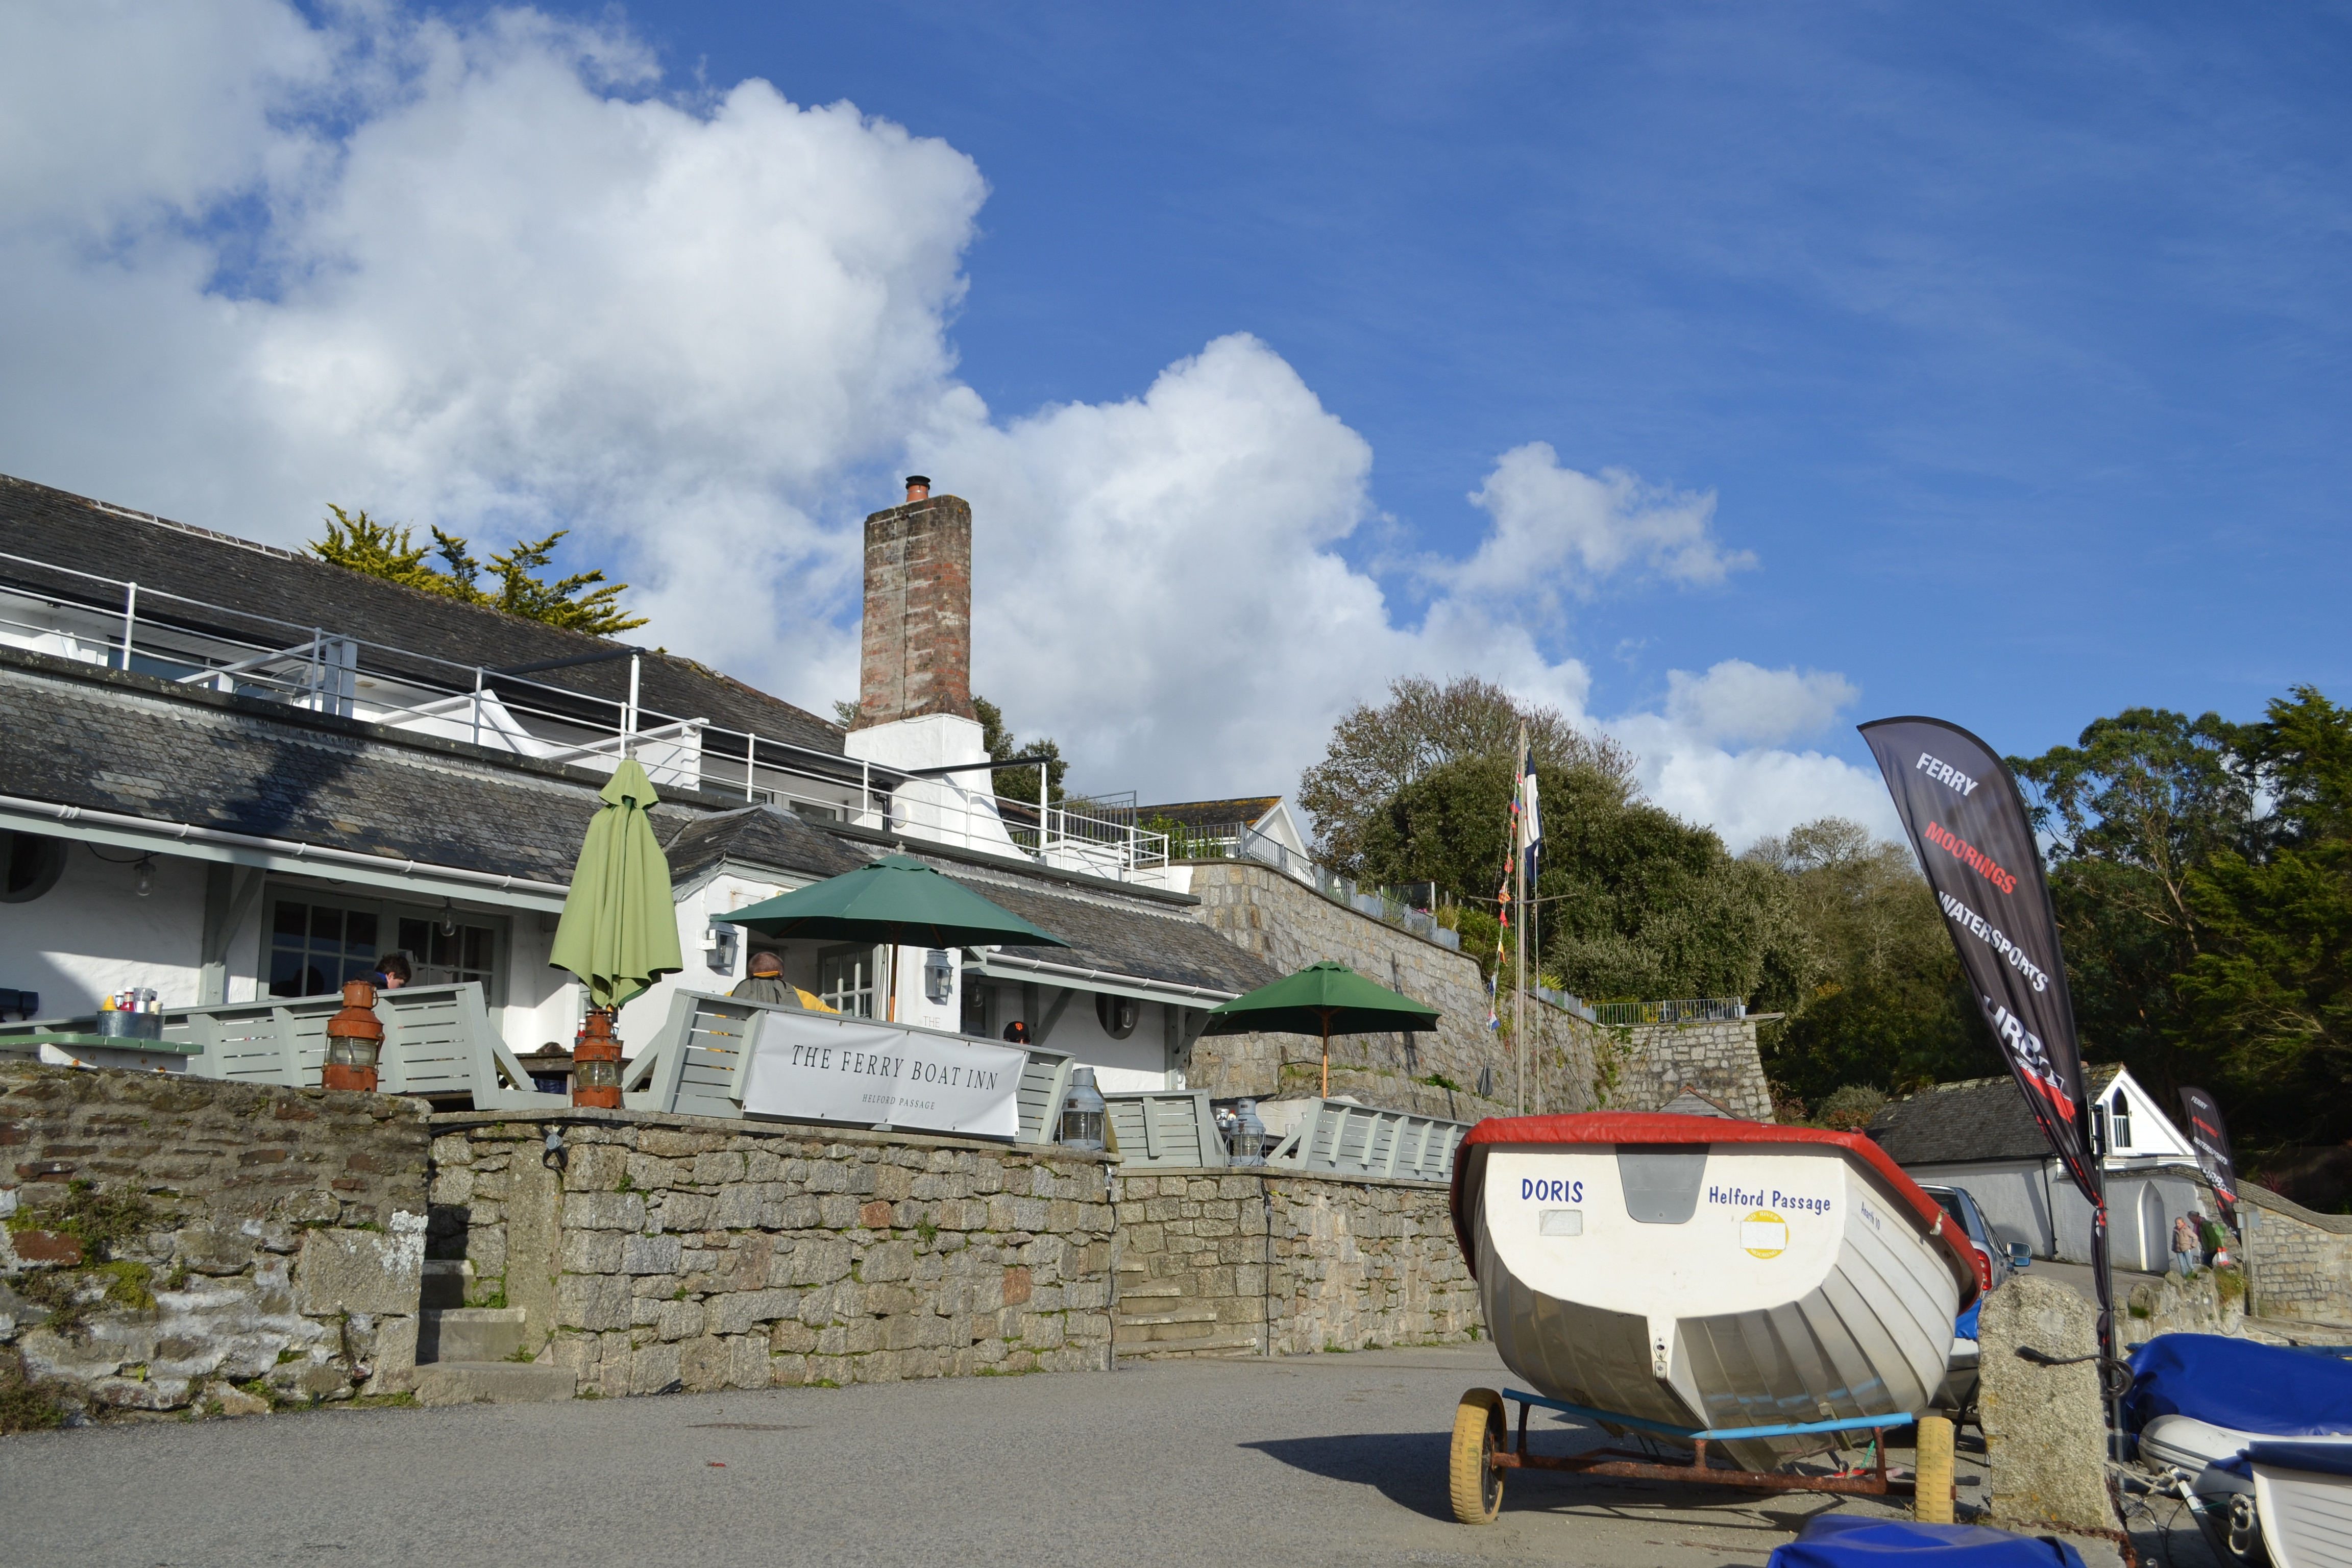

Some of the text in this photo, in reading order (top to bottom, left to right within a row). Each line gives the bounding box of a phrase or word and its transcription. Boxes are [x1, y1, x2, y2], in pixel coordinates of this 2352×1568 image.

[1916, 752, 1978, 796] FERRY
[1924, 821, 2017, 894] MOORINGS
[1939, 891, 2048, 992] WATERSPORTS
[923, 1016, 940, 1028] THE
[792, 1044, 998, 1091] THE FERRY BOAT INN
[862, 1094, 935, 1110] HELFORD PASSAGE
[2191, 1095, 2208, 1110] FERRY
[2193, 1136, 2228, 1165] WATERSPORTS
[1522, 1179, 1583, 1203] DORIS
[1709, 1186, 1831, 1216] Helford Passage
[1759, 1211, 1778, 1221] RIVER
